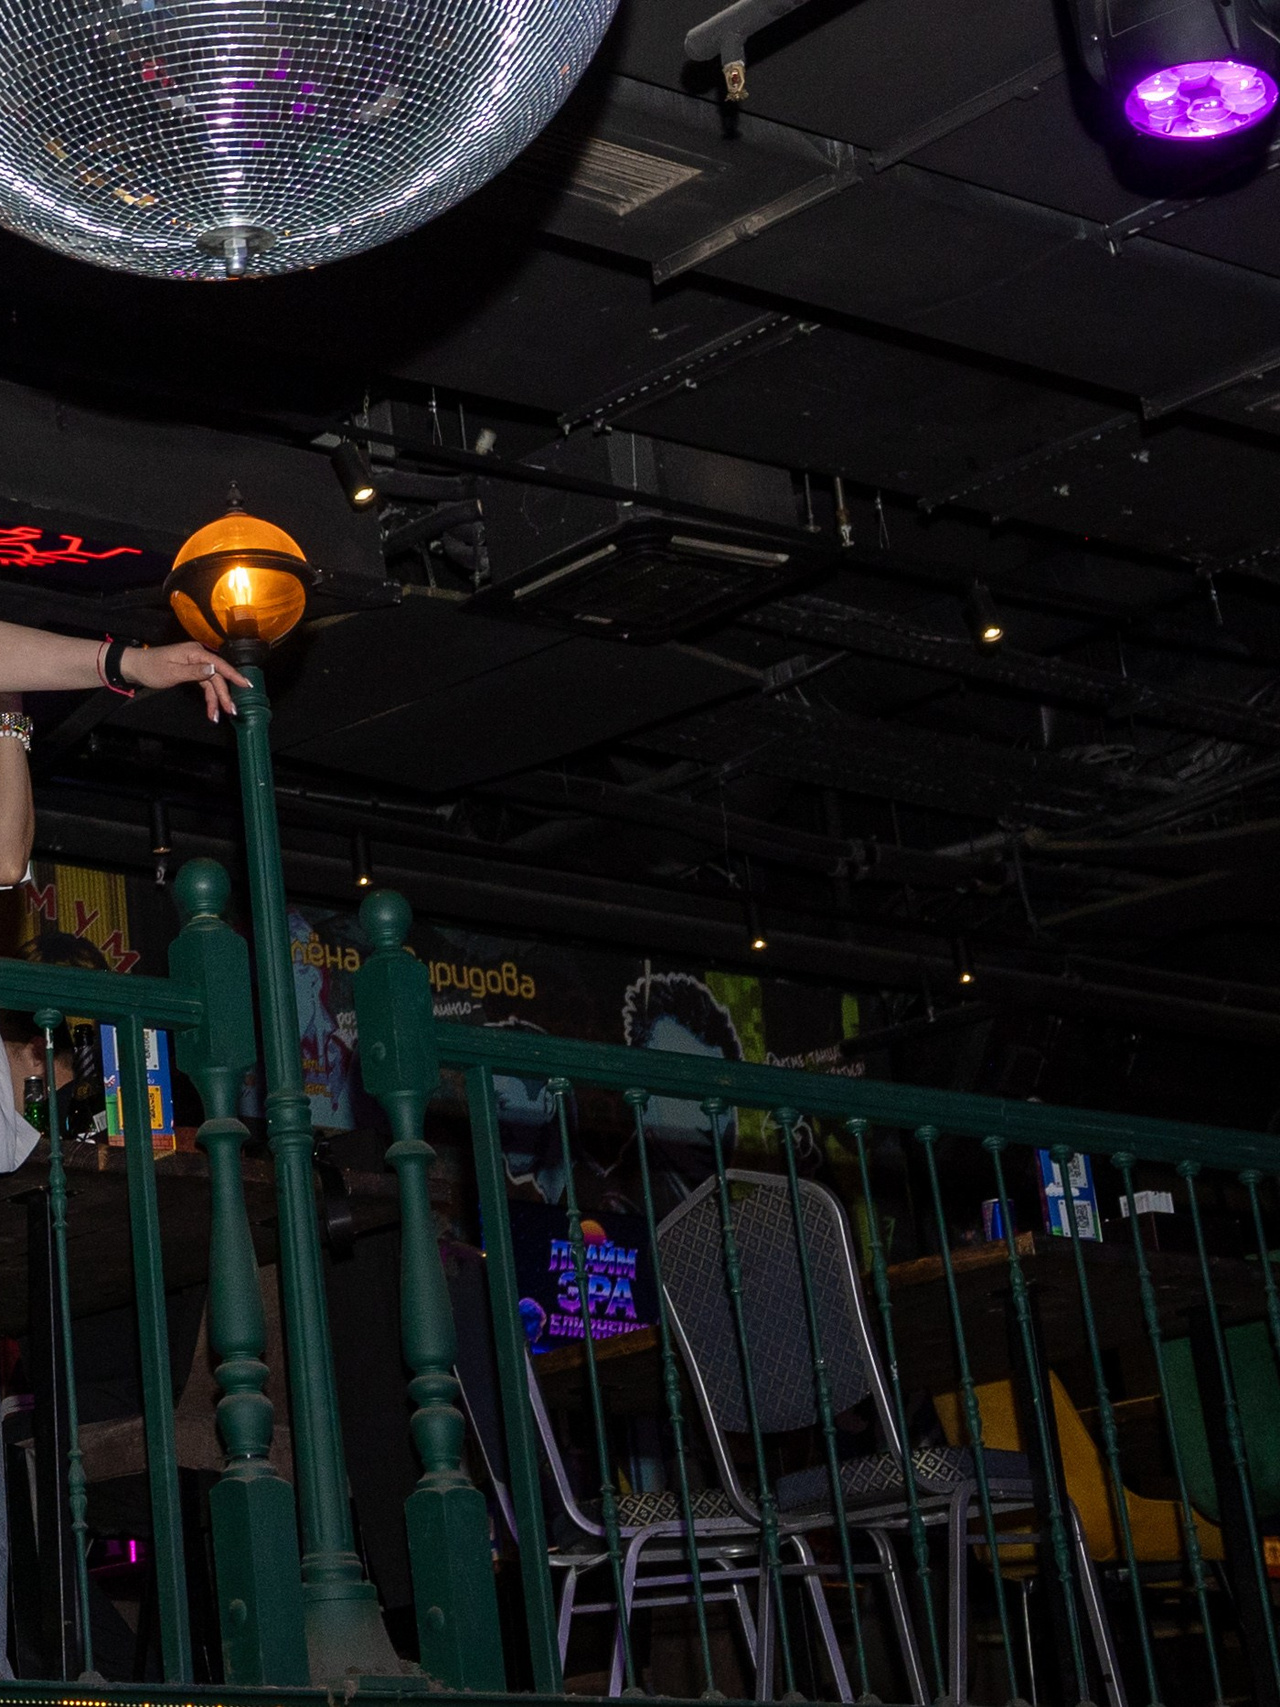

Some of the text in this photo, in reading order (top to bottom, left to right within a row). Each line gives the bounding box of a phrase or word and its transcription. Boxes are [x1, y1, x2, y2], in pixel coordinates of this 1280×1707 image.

[290, 932, 537, 1000] лёна ридова
[557, 1271, 637, 1320] ЭРА
